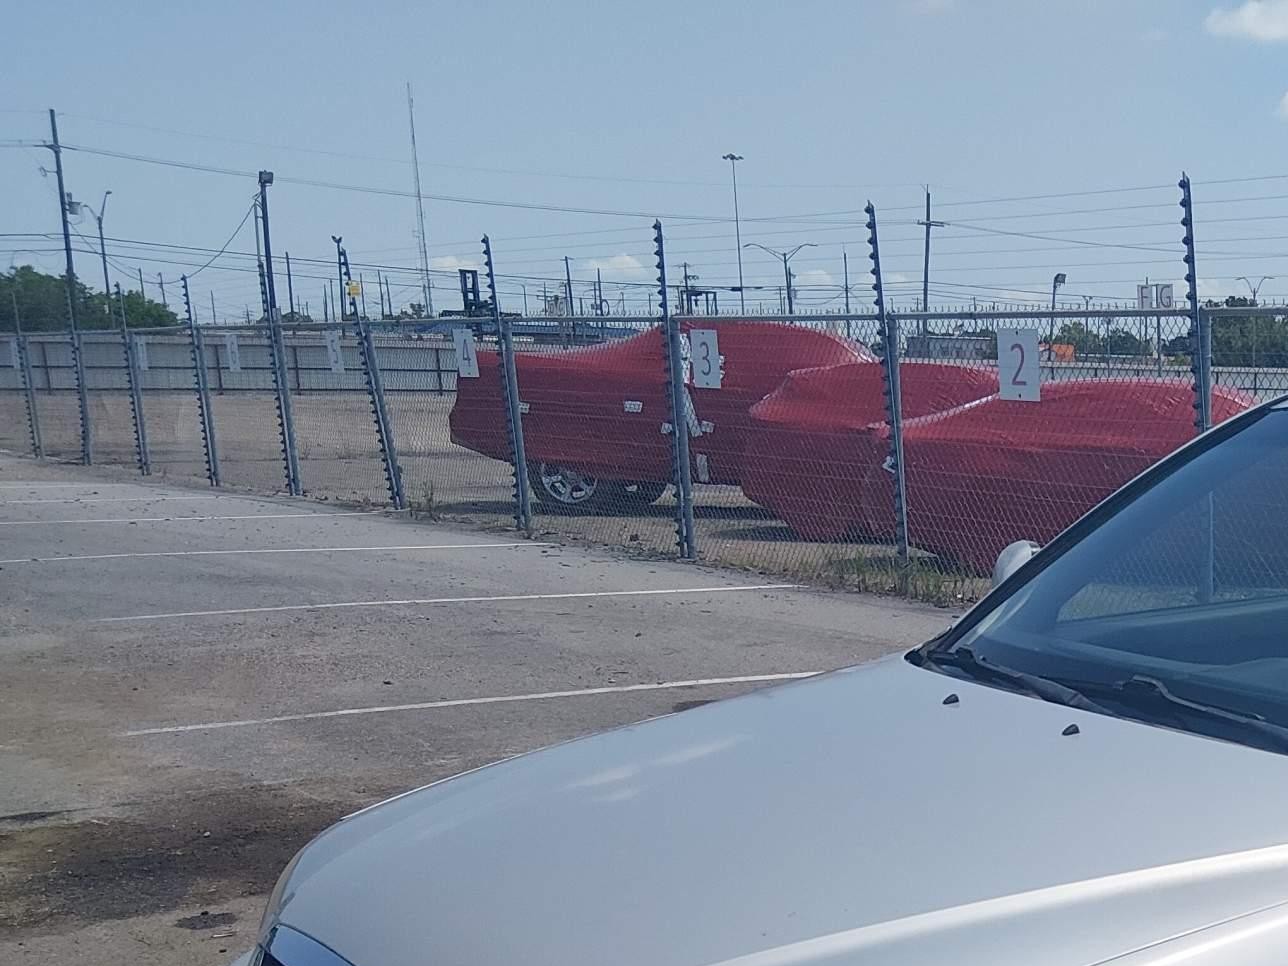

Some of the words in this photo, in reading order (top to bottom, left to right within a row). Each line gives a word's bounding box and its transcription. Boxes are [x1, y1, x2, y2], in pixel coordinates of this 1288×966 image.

[462, 338, 472, 368] 4
[700, 341, 712, 377] 3
[1010, 343, 1027, 386] 2
